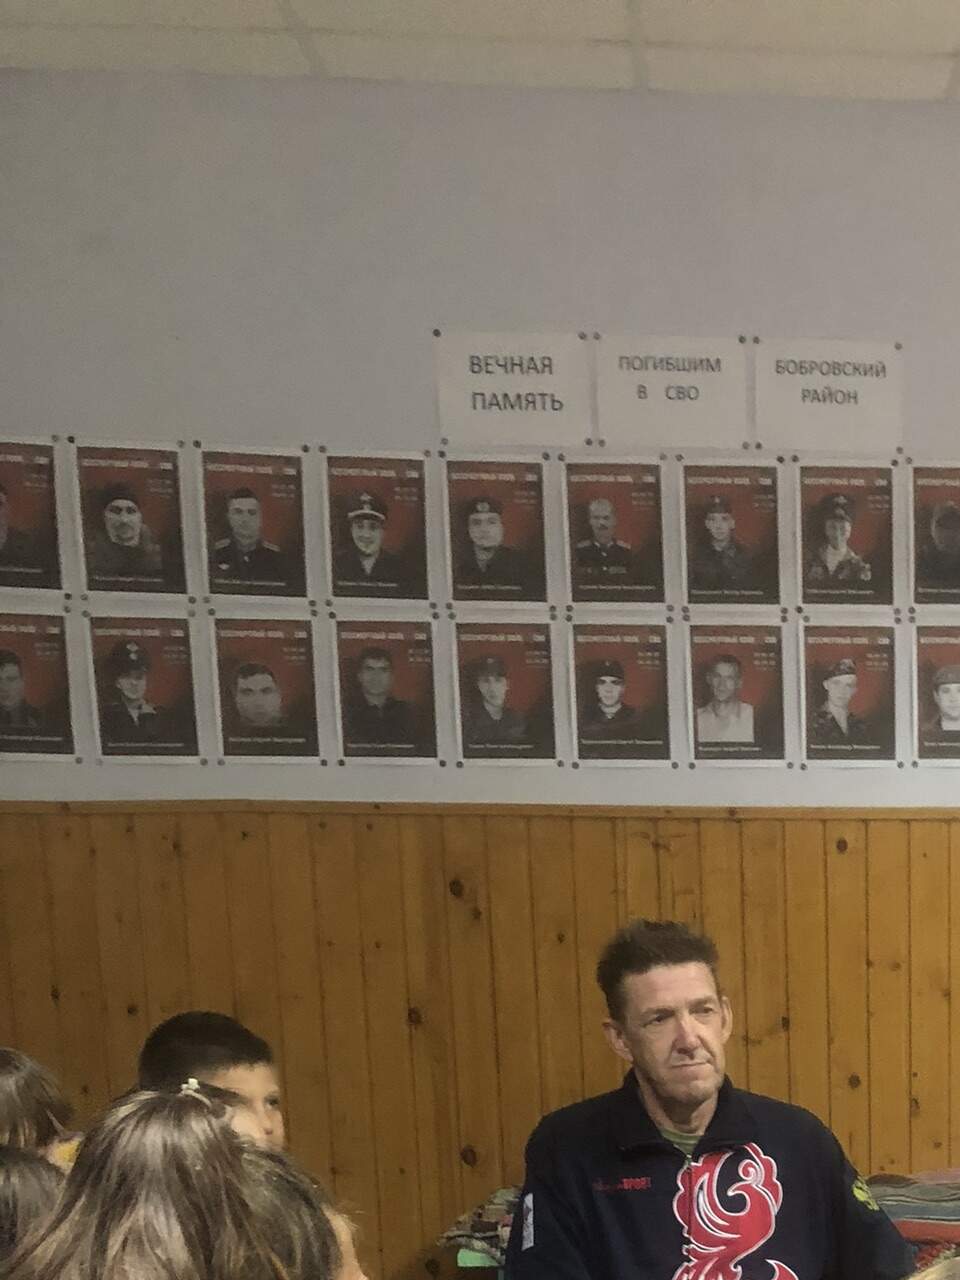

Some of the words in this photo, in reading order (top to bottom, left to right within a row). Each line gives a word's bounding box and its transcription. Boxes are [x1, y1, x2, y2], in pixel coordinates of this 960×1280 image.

[469, 356, 553, 375] ВЕЧНАЯ
[618, 356, 722, 373] ПОГИБШИМ
[775, 359, 887, 378] БОБРОВСКИЙ
[471, 392, 564, 411] ПАМЯТЬ
[637, 384, 648, 400] В
[665, 385, 700, 401] СВО
[801, 385, 859, 405] РАЙОН
